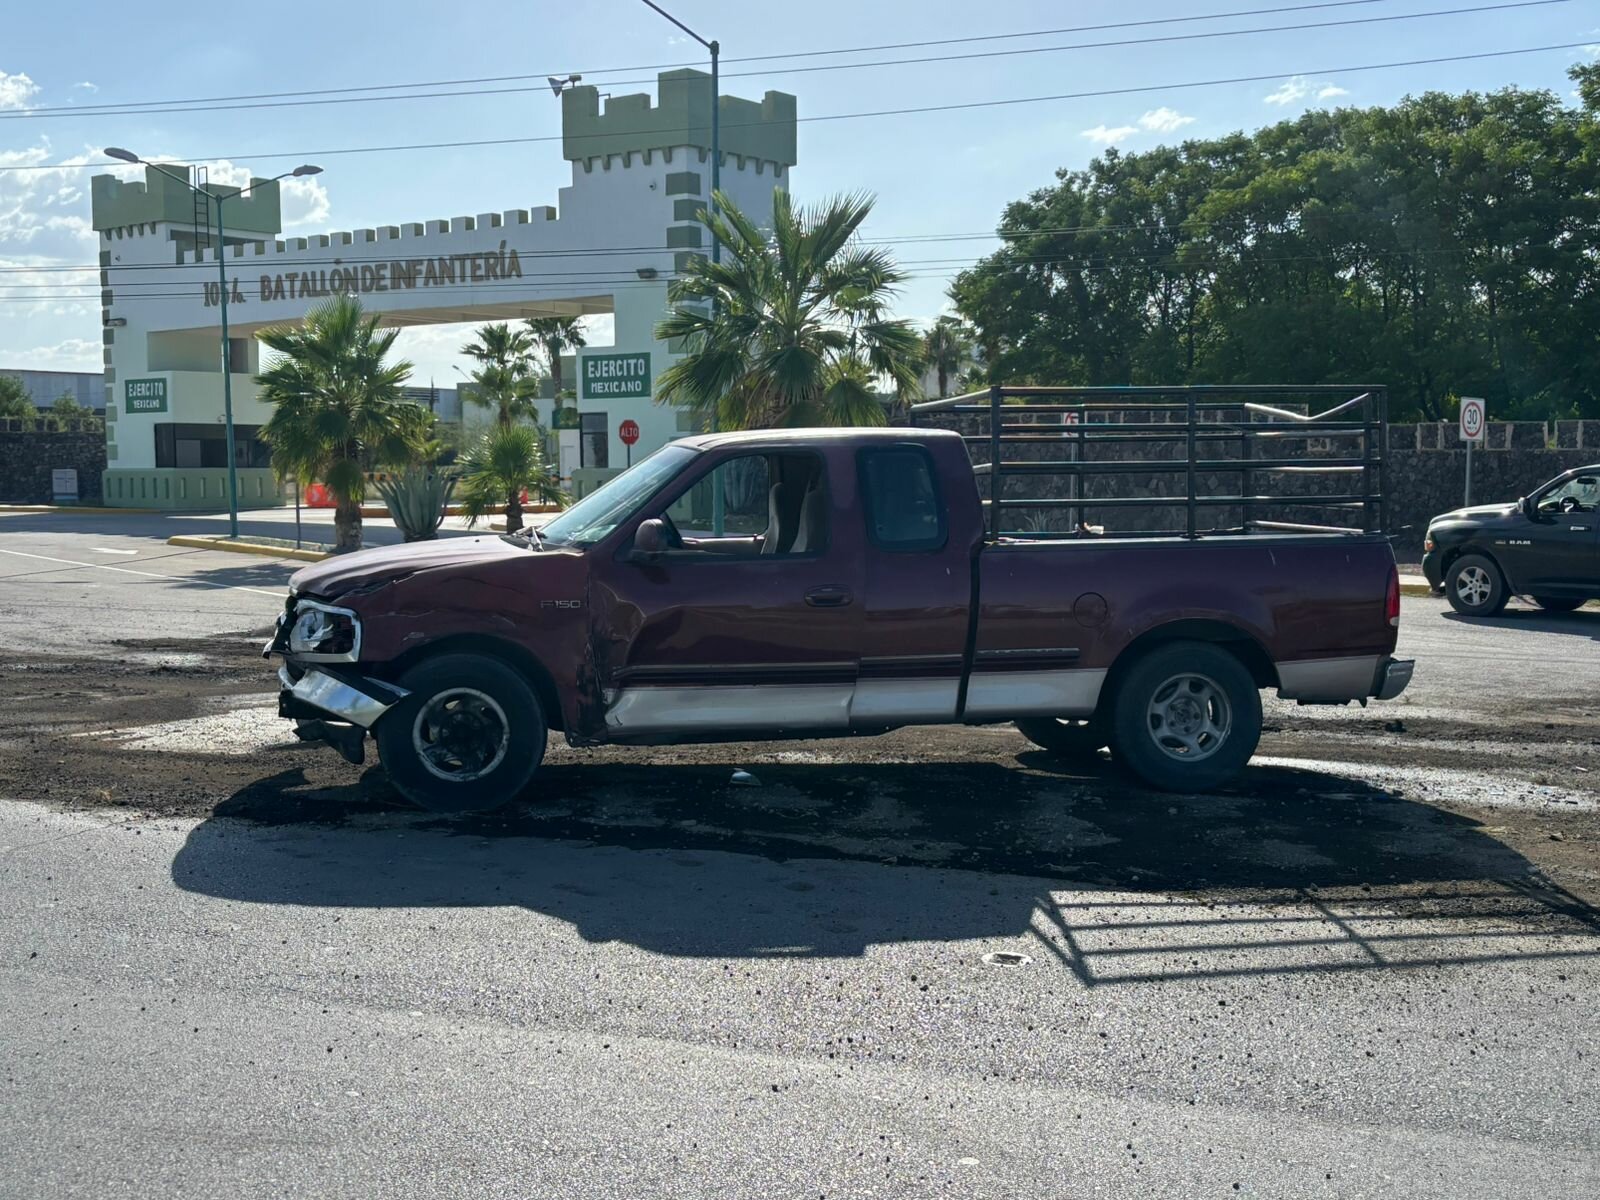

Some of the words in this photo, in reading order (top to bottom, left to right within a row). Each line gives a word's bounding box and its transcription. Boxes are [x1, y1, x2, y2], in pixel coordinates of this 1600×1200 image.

[260, 258, 359, 301] BATALLÓN
[361, 264, 388, 293] DE
[391, 240, 522, 290] INFANTERÍA
[587, 359, 645, 378] EJERCITO
[128, 382, 164, 397] EJERCITO
[591, 380, 642, 393] MEXICANO
[1466, 408, 1478, 425] 30
[620, 427, 638, 437] ALTO
